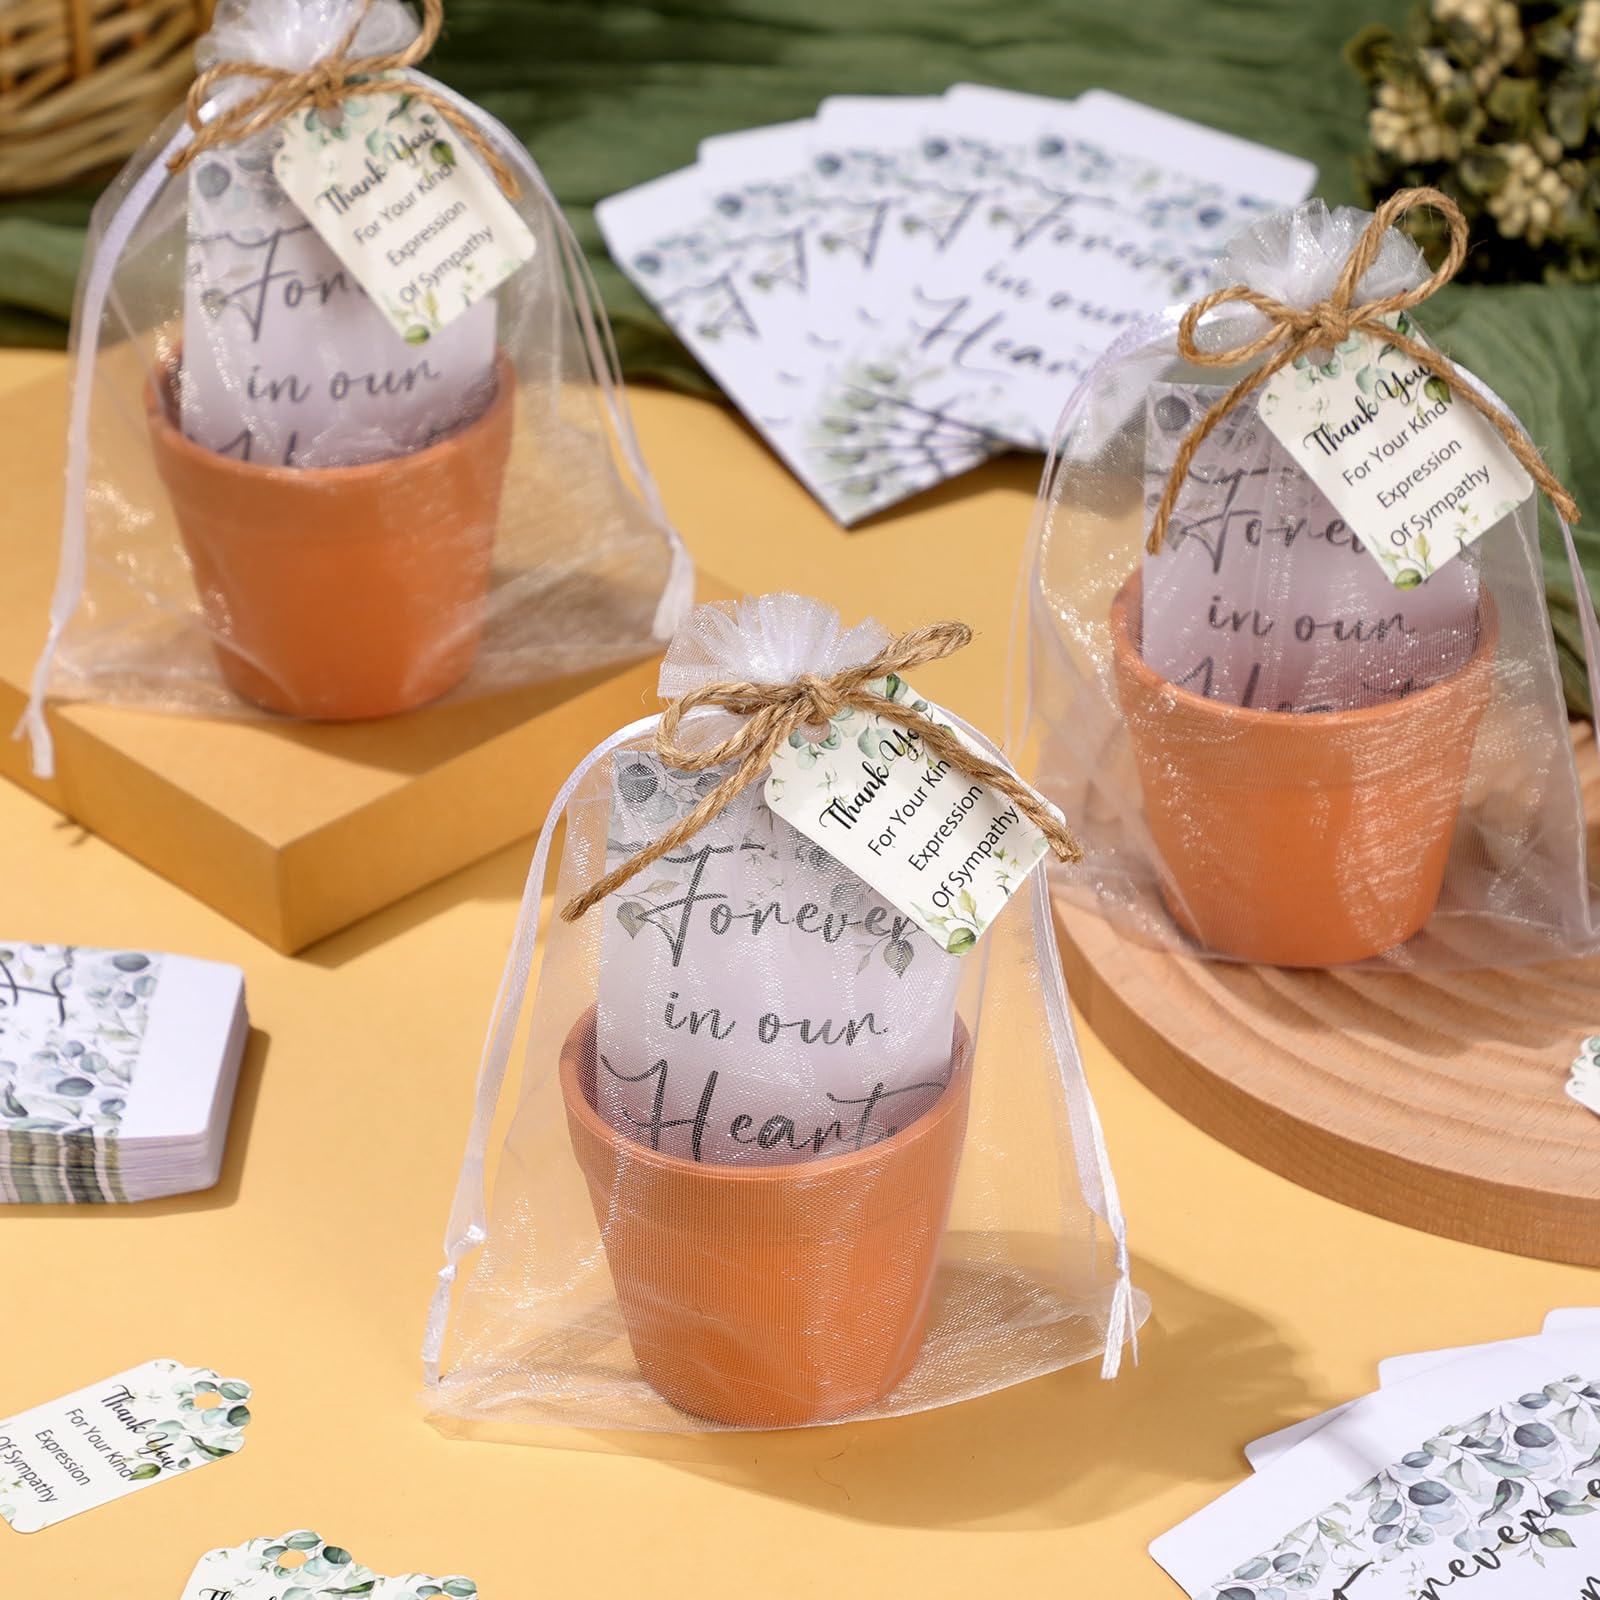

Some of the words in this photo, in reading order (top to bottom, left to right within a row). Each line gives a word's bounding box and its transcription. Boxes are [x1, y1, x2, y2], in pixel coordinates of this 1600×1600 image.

[315, 158, 387, 216] Thank
[383, 124, 438, 169] You
[352, 220, 382, 246] For
[380, 191, 418, 224] Your
[417, 160, 458, 194] Kind
[386, 199, 467, 268] Expression
[399, 278, 424, 304] Of
[418, 225, 496, 290] Sympathy
[246, 365, 311, 401] in
[329, 358, 441, 400] our
[1303, 394, 1379, 456] Thank
[1374, 364, 1434, 407] You
[1342, 461, 1372, 486] For
[1369, 430, 1410, 464] Your
[1408, 397, 1449, 435] Kind
[1376, 437, 1462, 508] Expression
[1390, 519, 1414, 547] Of
[1410, 463, 1491, 532] Sympathy
[1208, 594, 1274, 641] in
[1294, 611, 1416, 643] our
[818, 760, 890, 830] Thank
[878, 726, 922, 763] Yo
[867, 826, 897, 857] For
[889, 785, 929, 826] Your
[922, 758, 952, 790] Kin
[908, 783, 984, 872] Expression
[932, 881, 957, 909] Of
[948, 803, 1021, 890] Sympathy
[662, 990, 736, 1041] in
[757, 1010, 889, 1047] our
[0, 1436, 17, 1451] Of
[35, 1428, 91, 1487] Expression
[65, 1407, 89, 1429] For
[83, 1426, 112, 1453] Your
[105, 1451, 136, 1480] Kind
[100, 1384, 157, 1434] Thank
[136, 1431, 184, 1471] You
[3, 1449, 59, 1504] Sympathy
